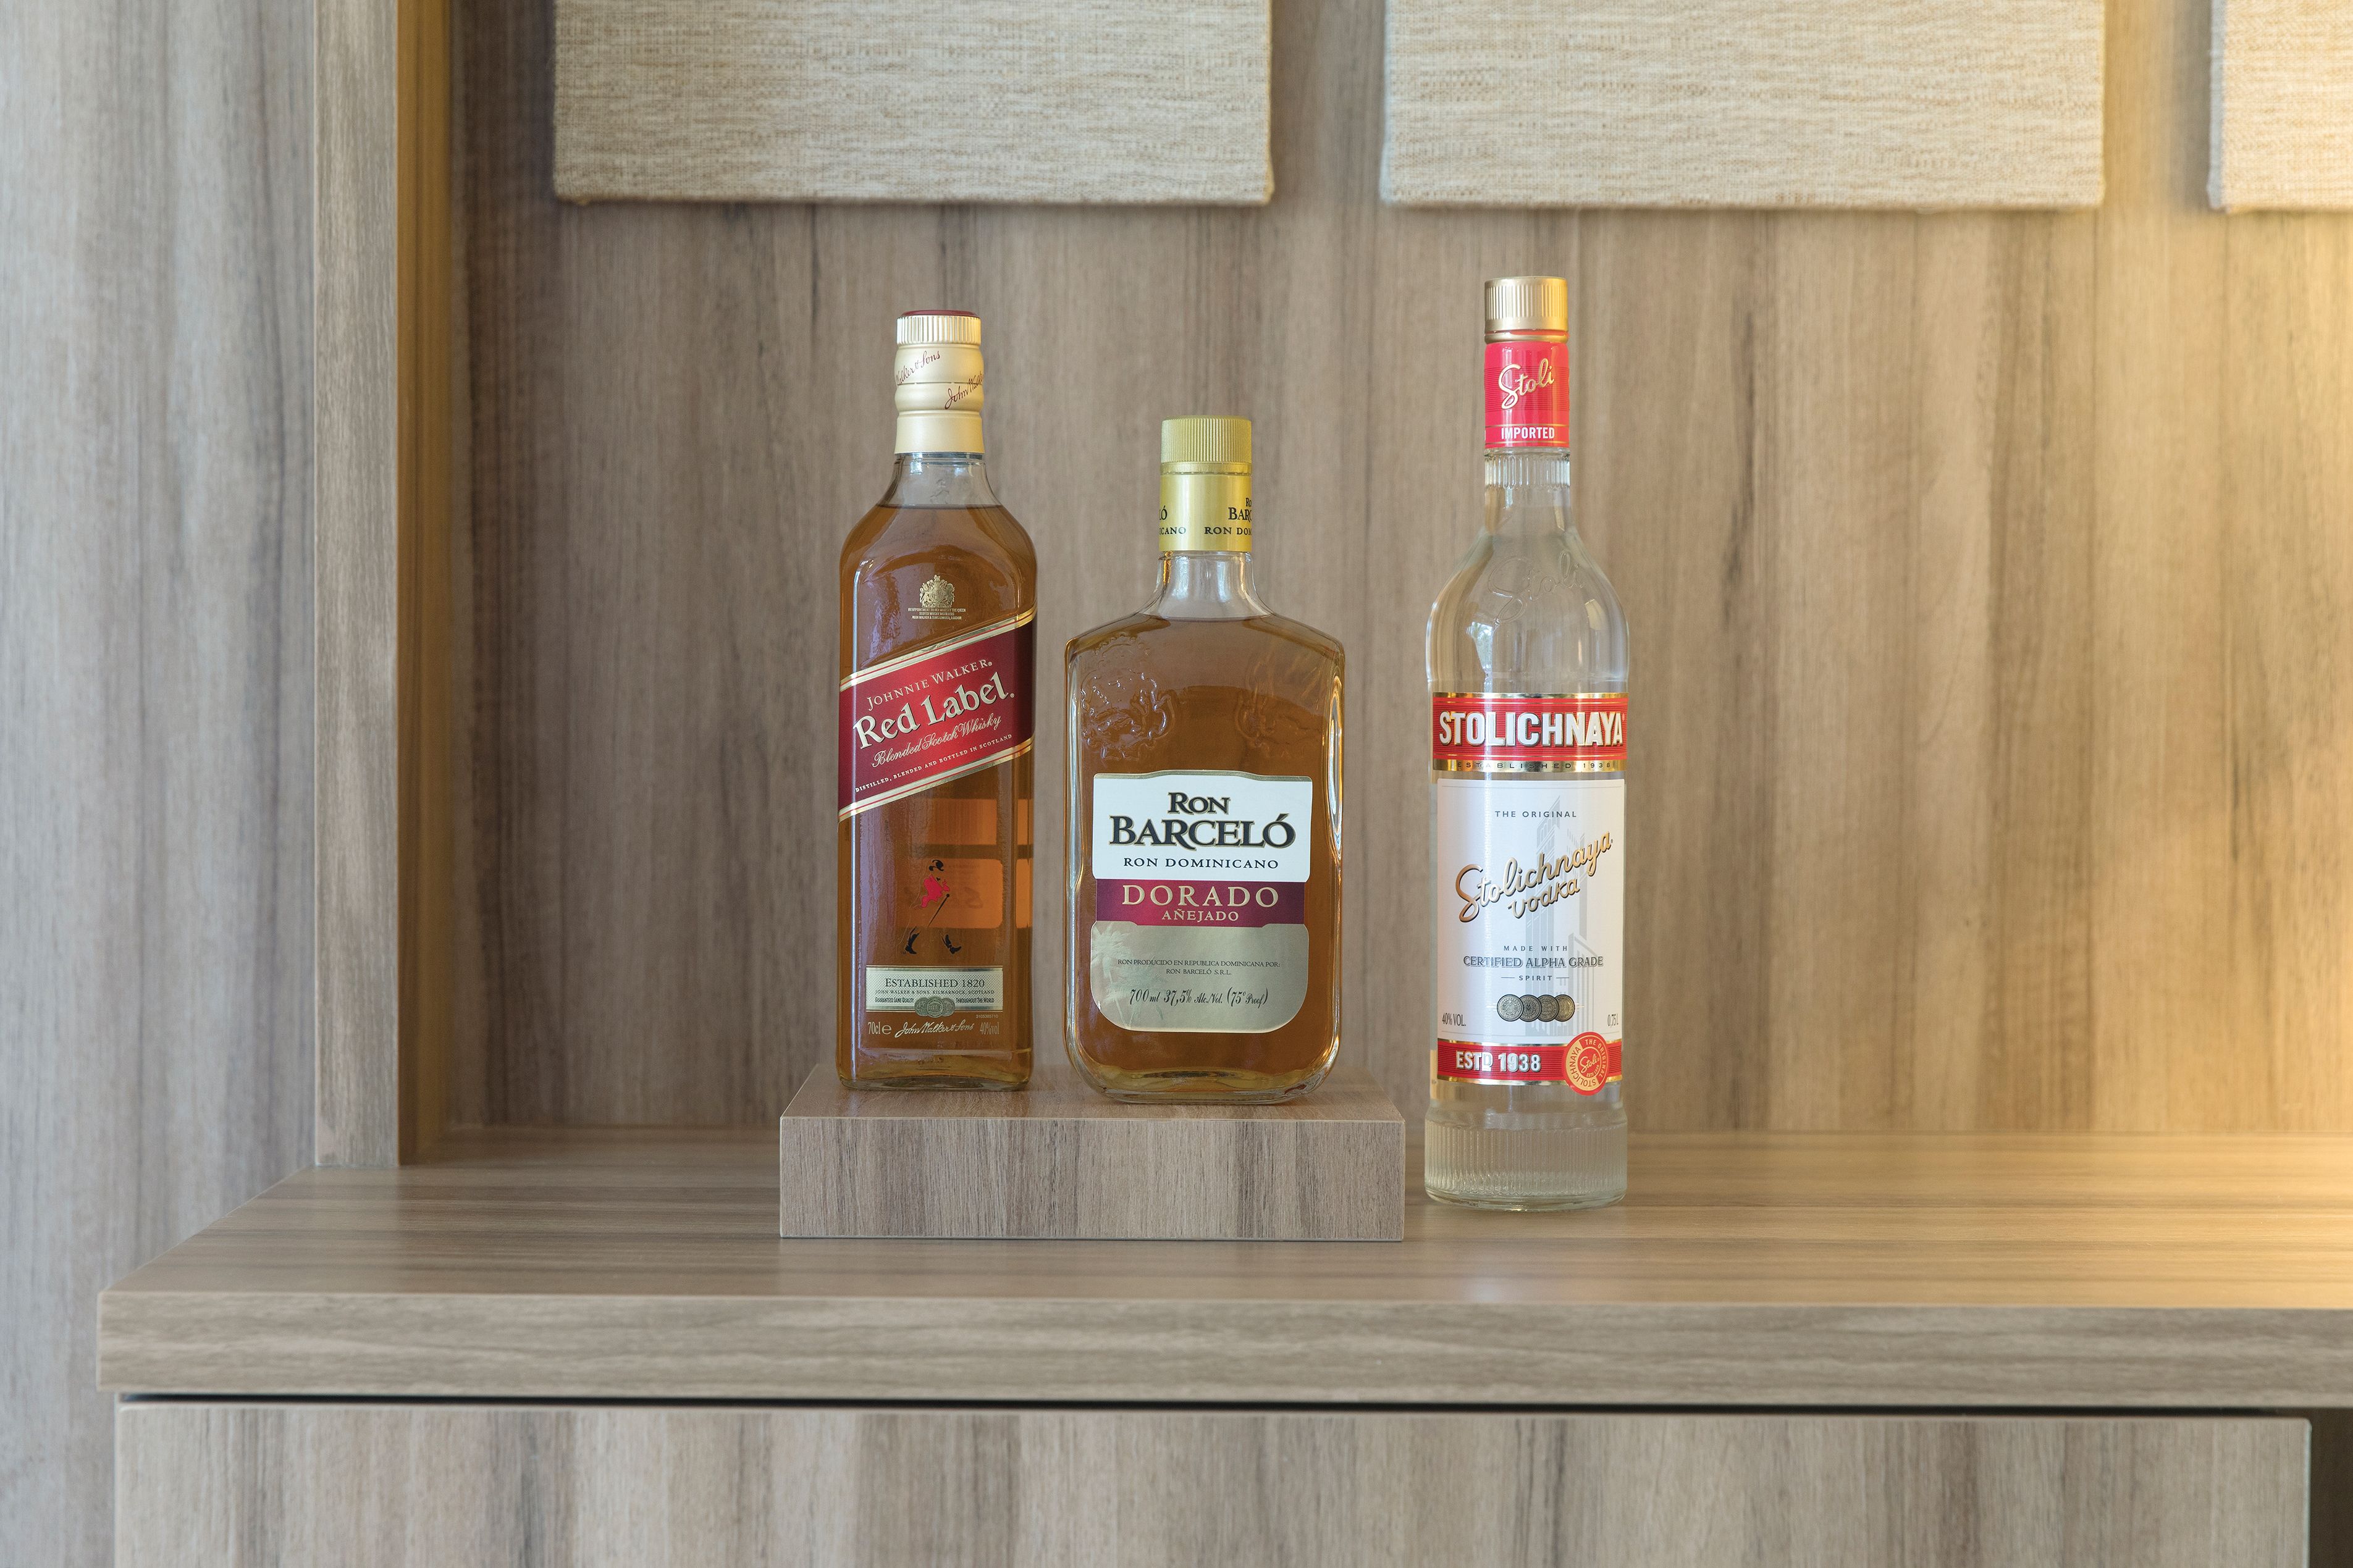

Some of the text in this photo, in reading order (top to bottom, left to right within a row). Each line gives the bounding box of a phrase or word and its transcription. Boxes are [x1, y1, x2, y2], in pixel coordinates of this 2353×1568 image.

[1498, 358, 1554, 409] Stoli
[945, 385, 968, 409] John
[1501, 427, 1555, 439] IMPORTED
[1205, 527, 1232, 535] RON
[867, 679, 930, 711] JOHNNIE
[853, 702, 921, 750] Red
[872, 713, 1001, 768] Blended Scotch Whisky
[855, 777, 892, 793] DISTILLED,
[893, 766, 922, 779] BLENDED
[925, 760, 937, 768] AND
[939, 750, 968, 763] BOTTLED
[979, 734, 1012, 750] SCOTLAND
[1167, 791, 1231, 815] RON
[1109, 813, 1296, 851] BARCELÓ
[1123, 857, 1279, 869] RON DOMINICANO
[1455, 831, 1612, 923] Stolichnaya
[1122, 885, 1279, 908] DORADO
[1508, 878, 1581, 918] vodka
[1161, 908, 1239, 922] AÑEJADO
[1463, 955, 1604, 968] CERTIFIED ALPHA GRADE
[885, 978, 985, 987] ESTABLISHED 1820
[1164, 989, 1192, 1007] 37,5%
[868, 1021, 880, 1034] 70cl
[894, 1022, 920, 1038] John
[921, 1021, 949, 1034] Walker
[956, 1019, 975, 1031] Sons
[1442, 1013, 1466, 1026] 40% VOL.
[1498, 1052, 1542, 1072] 1938
[1570, 1047, 1596, 1087] STOLICHNAYA
[1580, 1054, 1597, 1073] Stoli
[1597, 1043, 1606, 1078] ORIGINAL
